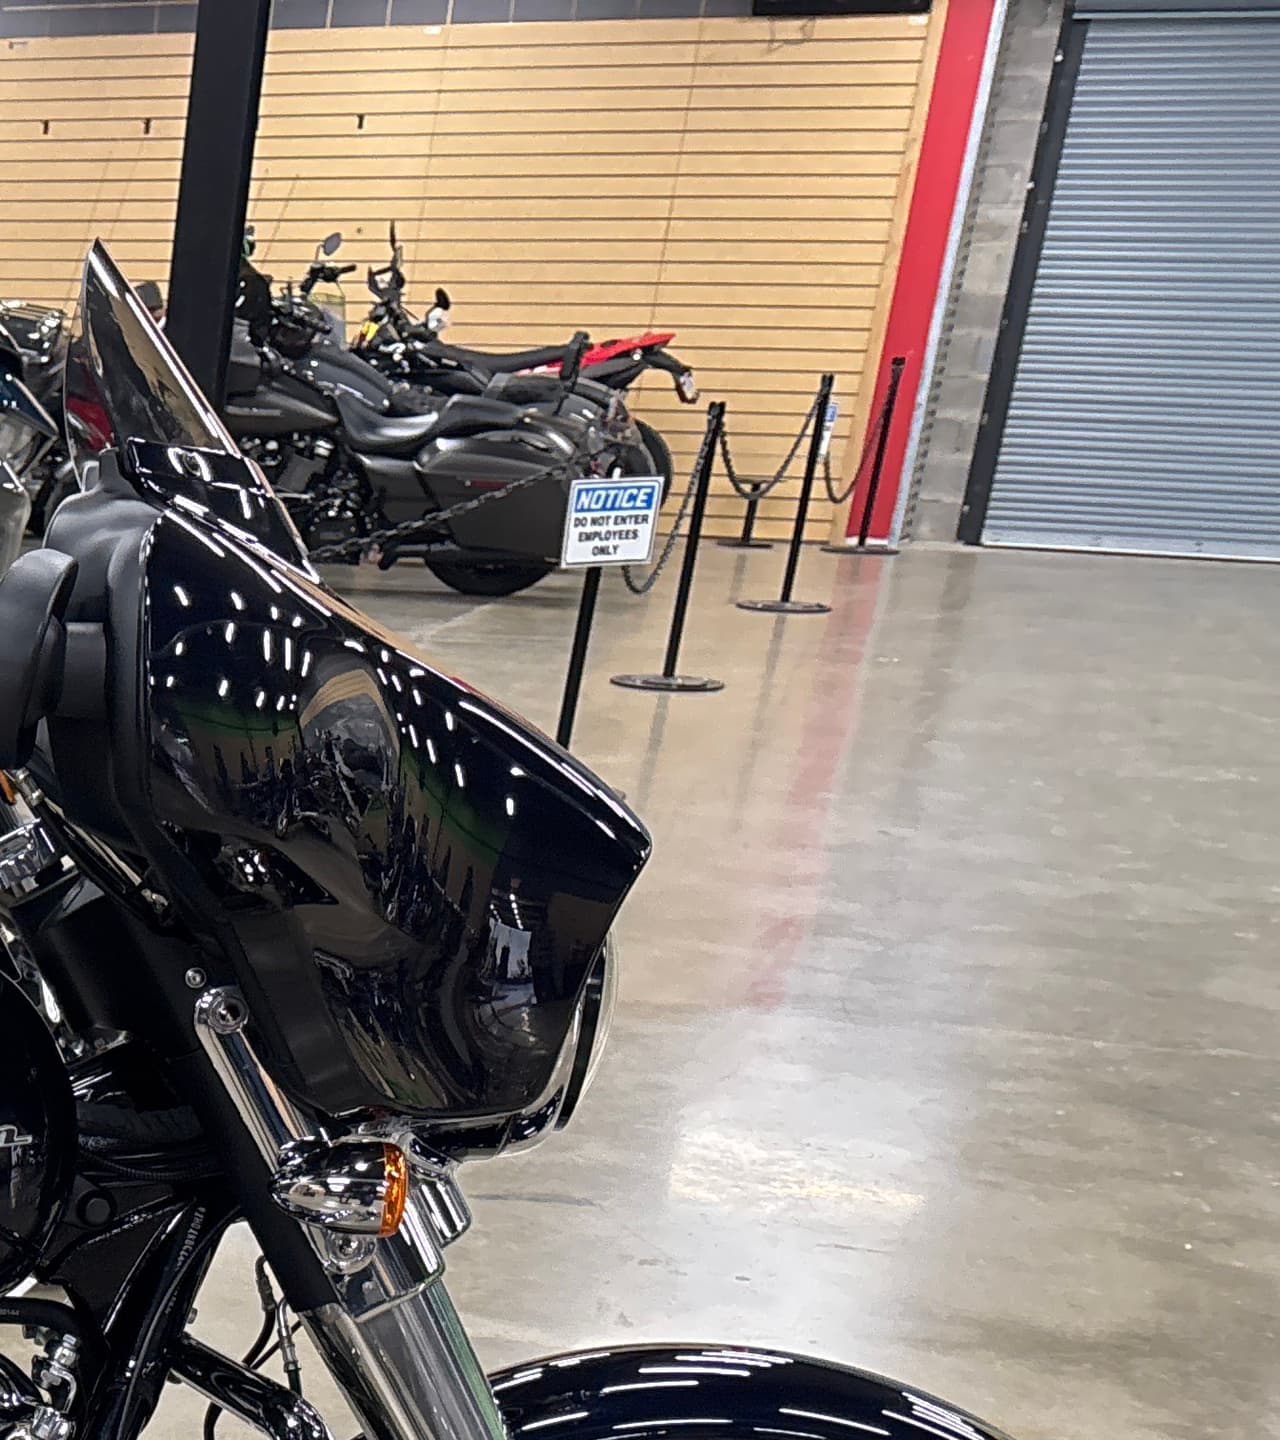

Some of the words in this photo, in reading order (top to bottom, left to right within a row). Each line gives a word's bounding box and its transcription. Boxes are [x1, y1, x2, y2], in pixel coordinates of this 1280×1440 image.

[576, 487, 653, 510] NOTICE
[573, 516, 588, 528] DO
[590, 515, 612, 527] NOT
[613, 514, 649, 526] ENTER
[578, 529, 639, 543] EMPLOYEES
[592, 544, 620, 557] ONLY
